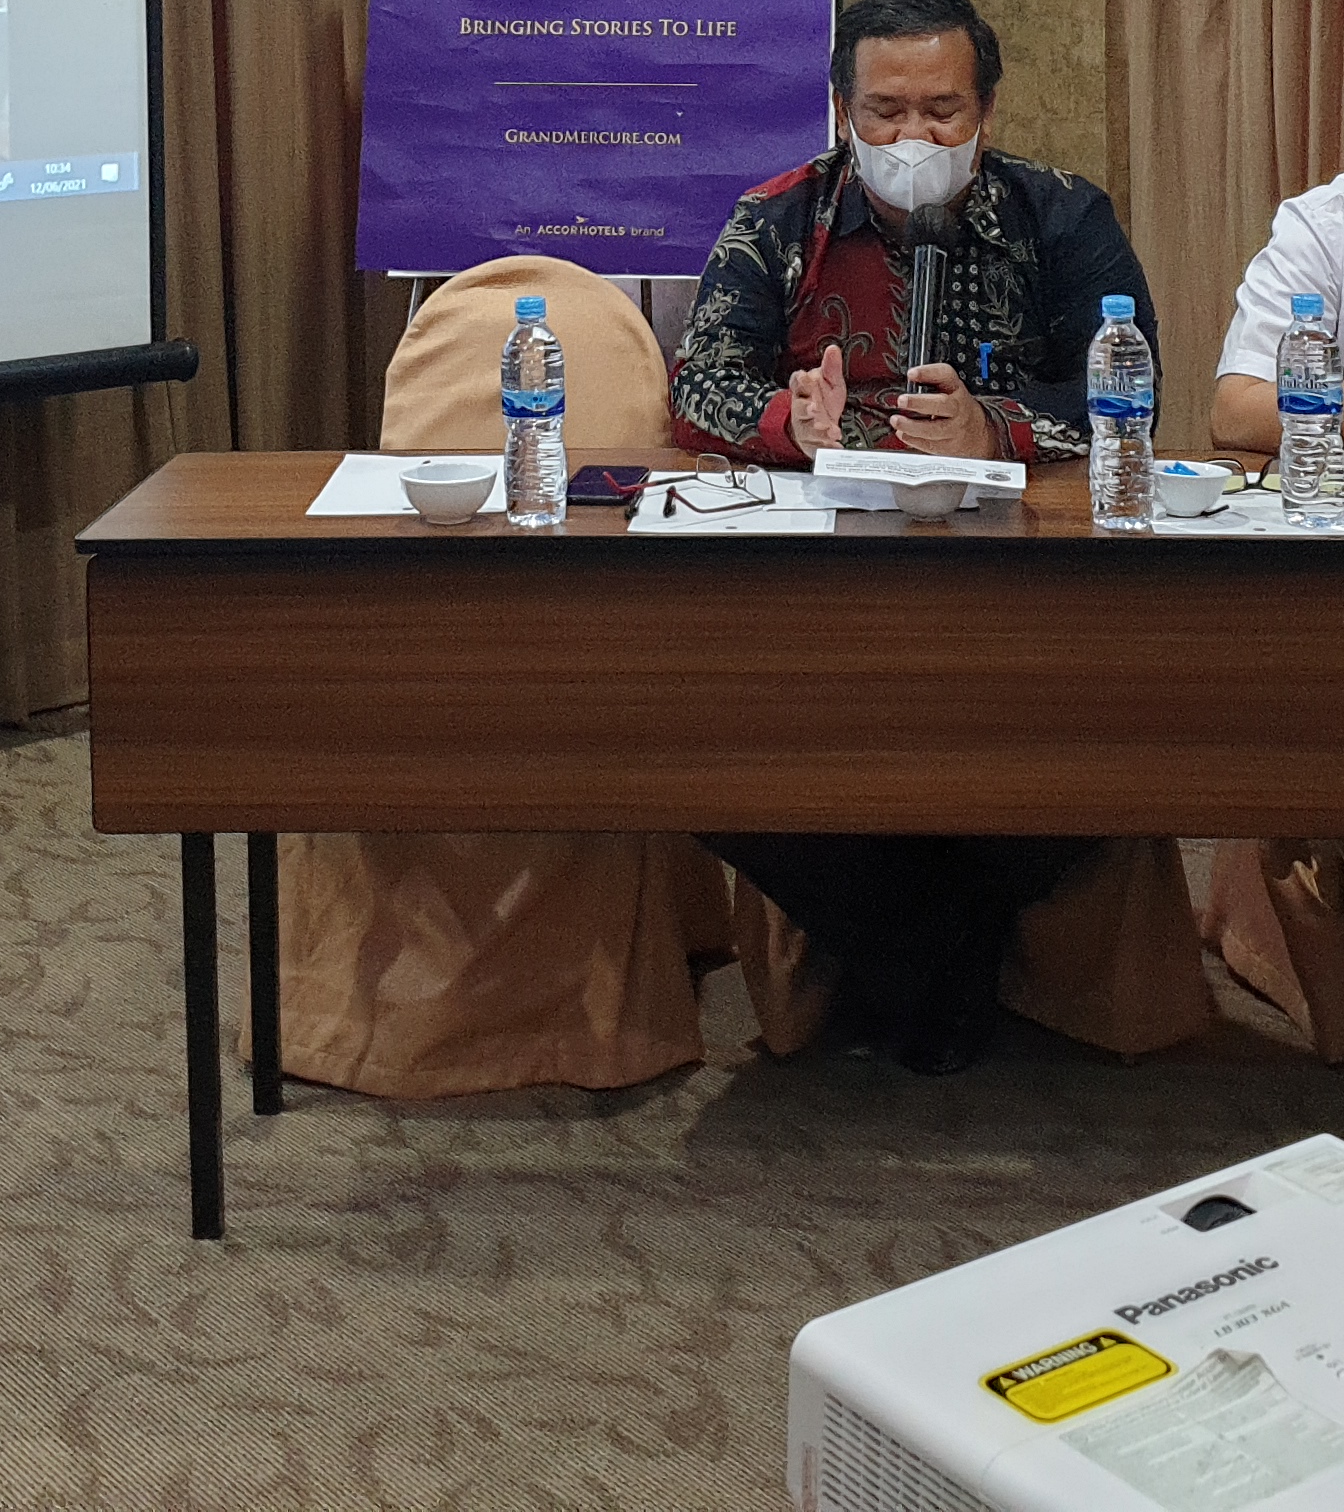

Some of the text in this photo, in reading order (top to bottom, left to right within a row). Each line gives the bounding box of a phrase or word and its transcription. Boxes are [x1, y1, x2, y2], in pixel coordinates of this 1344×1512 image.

[459, 17, 564, 36] BRINGING
[570, 18, 652, 37] STORIES
[695, 19, 737, 37] LIFE
[514, 223, 532, 236] An
[630, 224, 664, 237] brand
[1113, 1255, 1280, 1326] Panasonic
[1011, 1341, 1098, 1381] WARNING
